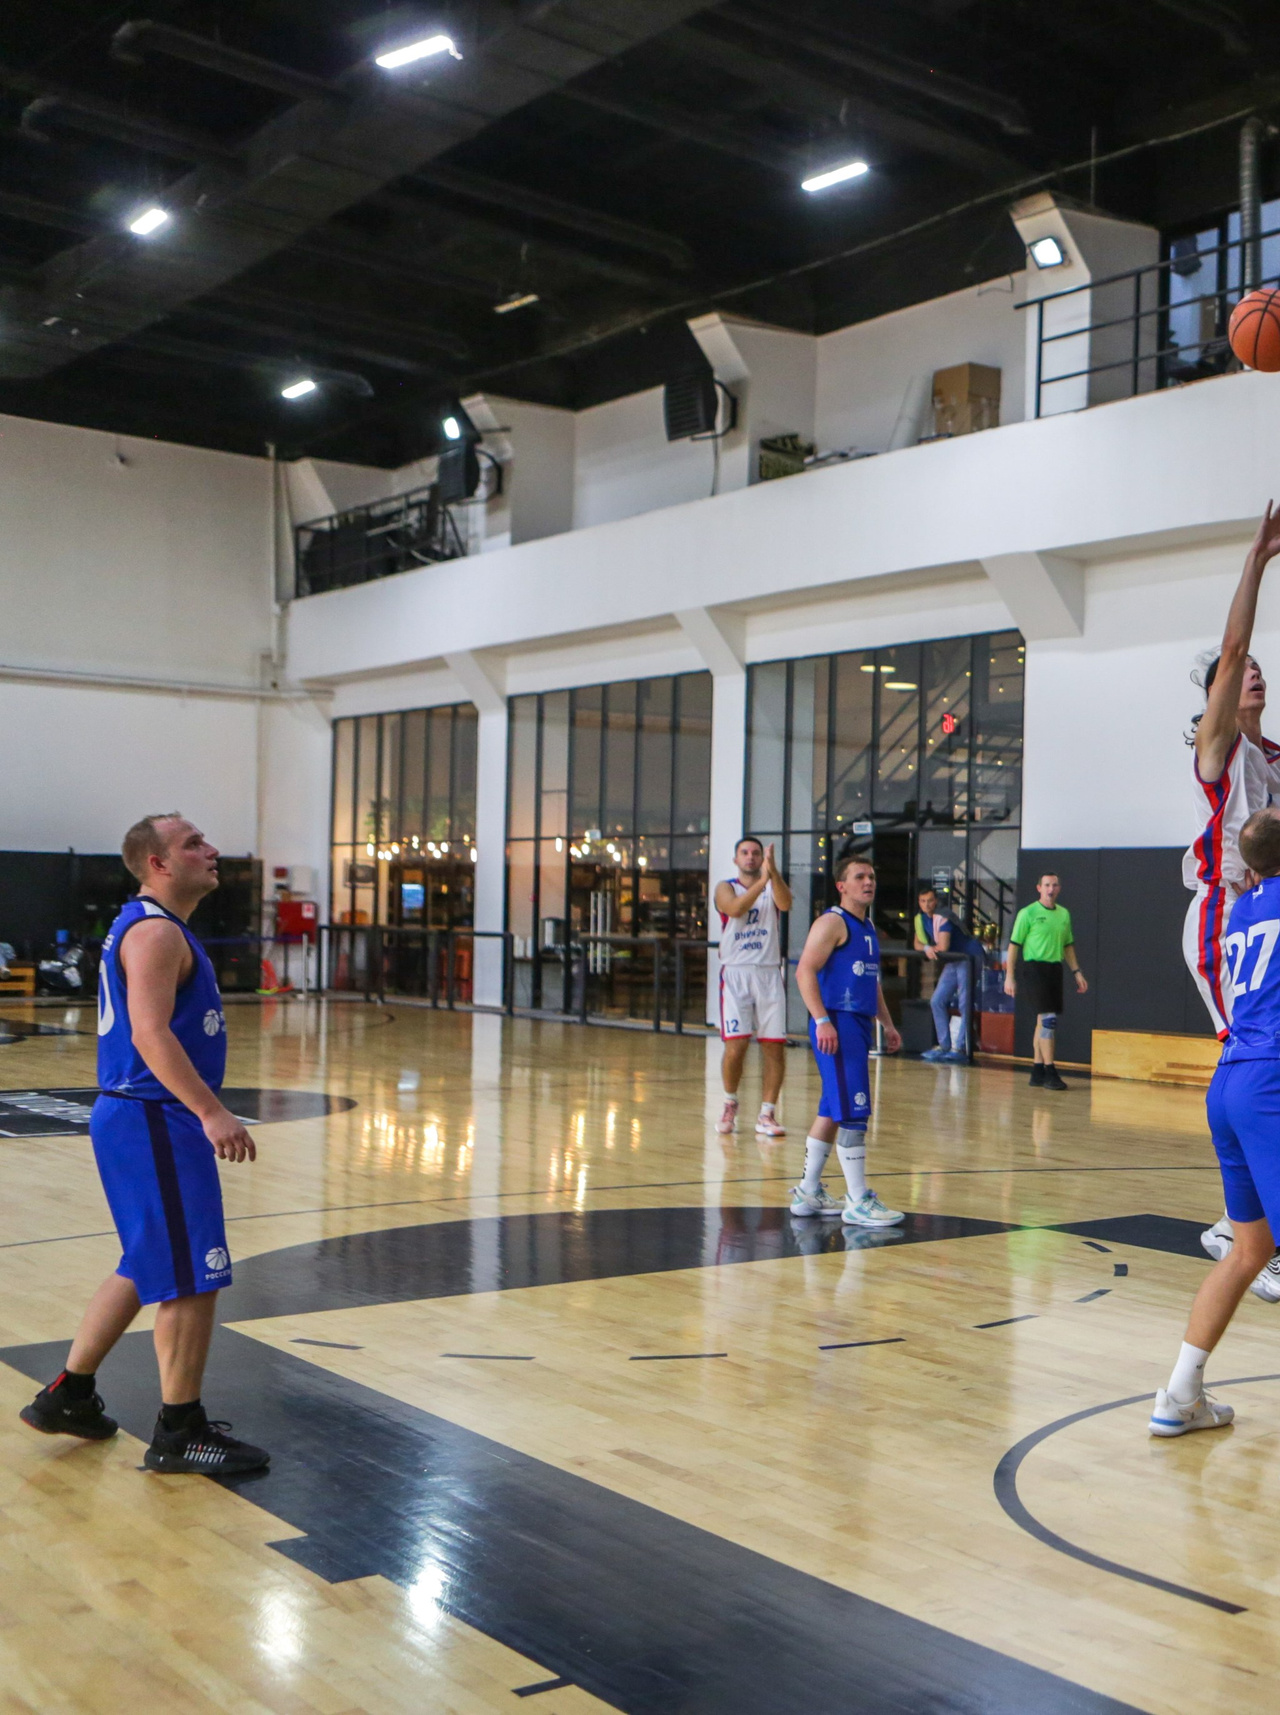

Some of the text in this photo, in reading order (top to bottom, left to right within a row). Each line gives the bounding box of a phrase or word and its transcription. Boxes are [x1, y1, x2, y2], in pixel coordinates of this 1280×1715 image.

[746, 908, 760, 925] 12
[739, 941, 763, 951] АРОВ
[864, 935, 873, 956] 7
[1226, 919, 1280, 997] 27
[726, 1019, 740, 1033] 12
